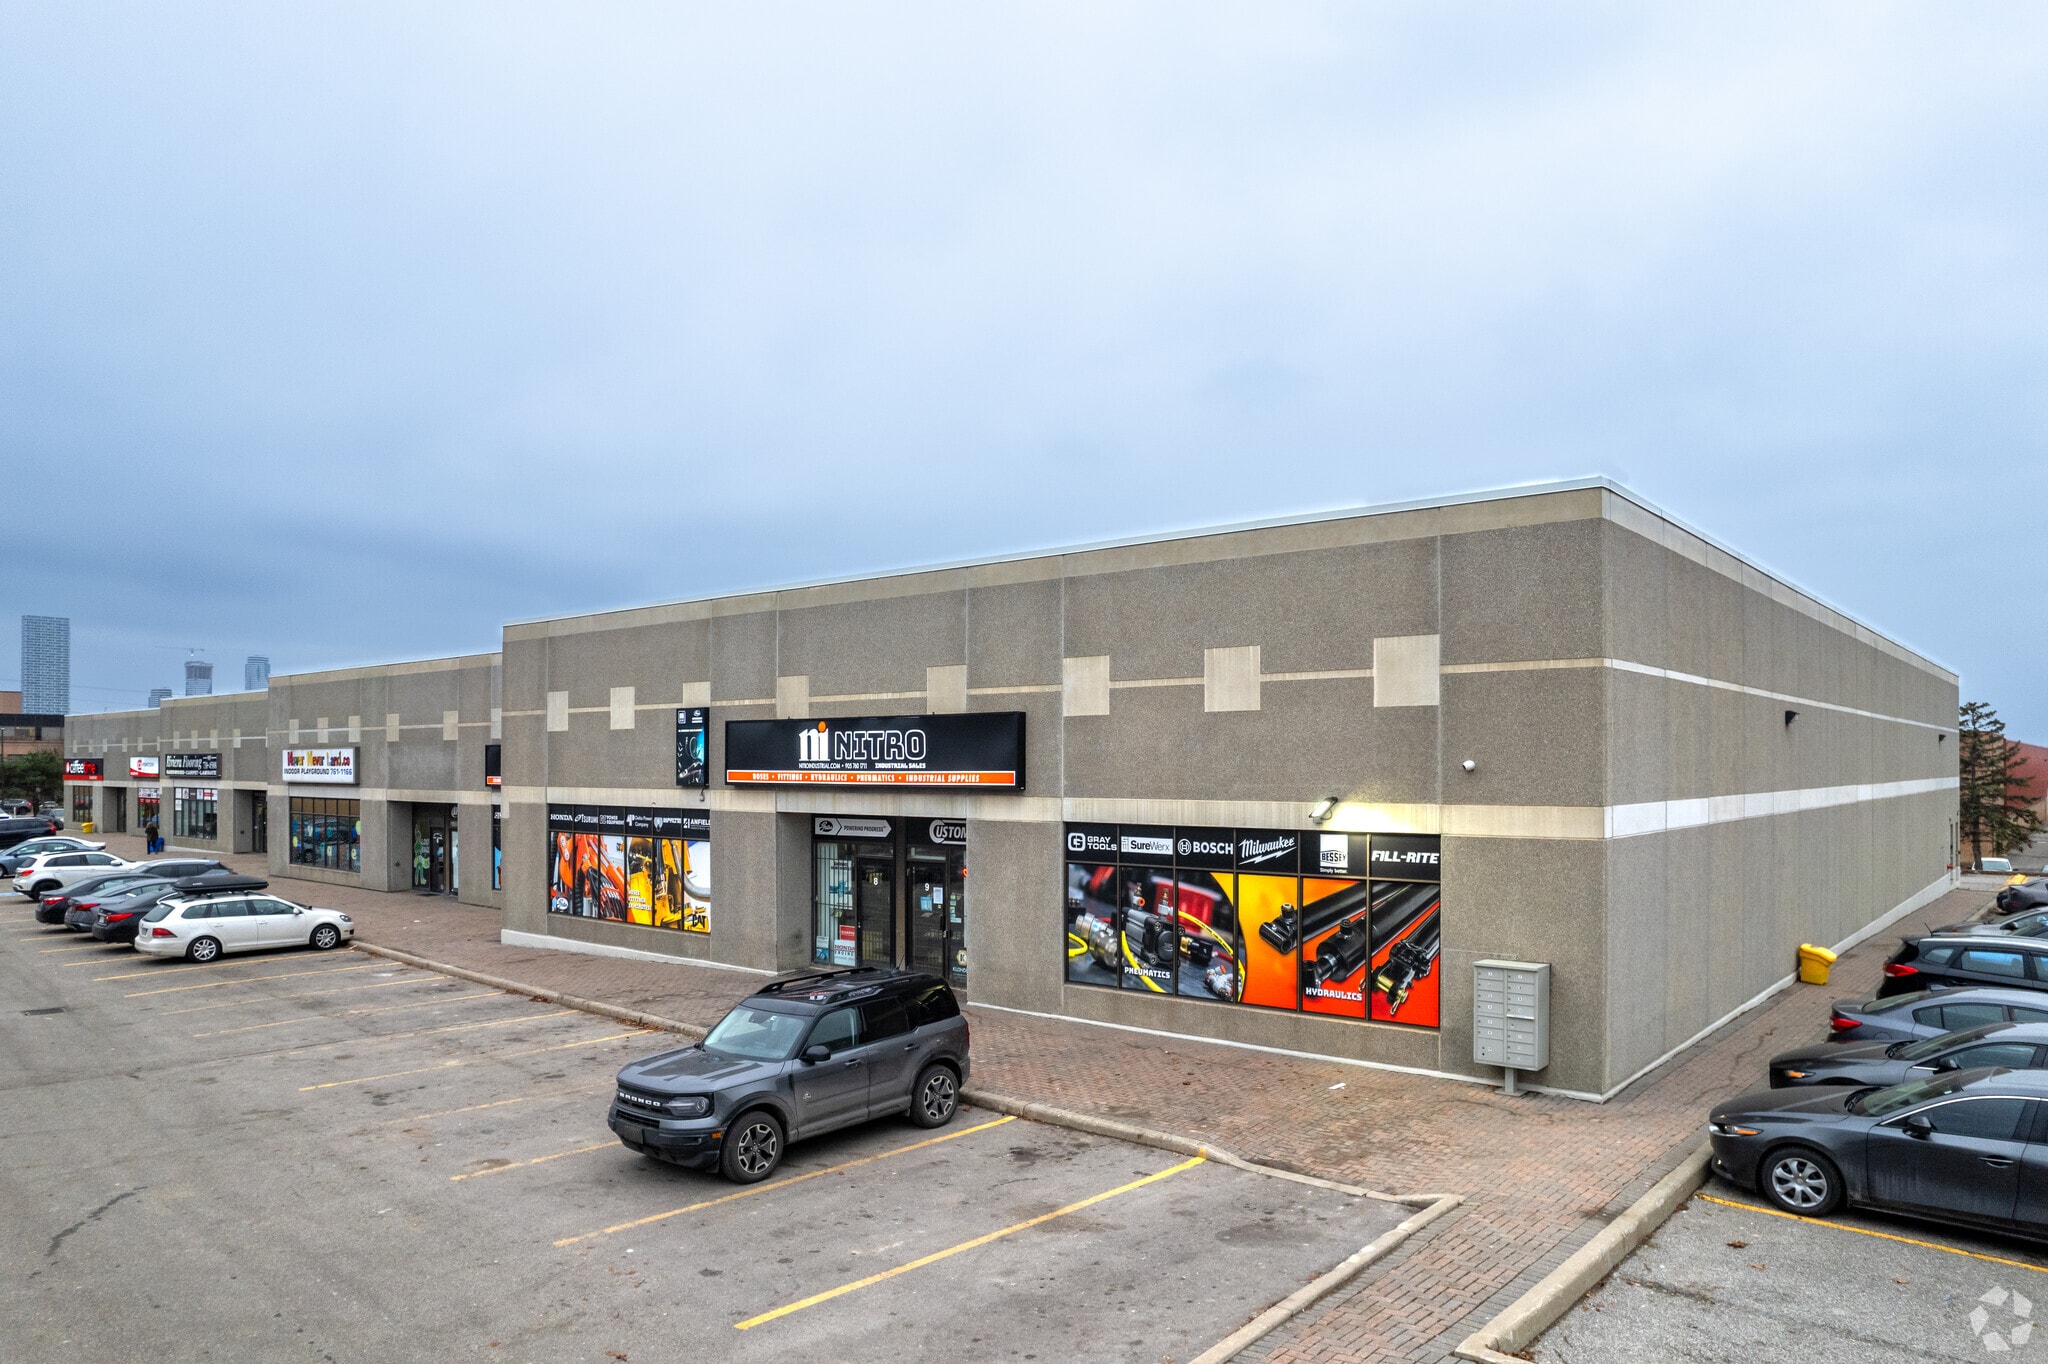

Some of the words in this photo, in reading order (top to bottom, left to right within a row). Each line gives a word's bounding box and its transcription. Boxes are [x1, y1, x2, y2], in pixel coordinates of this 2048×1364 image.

[834, 729, 927, 760] NITRO
[777, 773, 803, 781] FITTINGS
[810, 774, 848, 782] HYDRAULICS
[856, 774, 895, 782] PNEUMATICS
[905, 774, 945, 782] INDUSTRIAL
[947, 774, 980, 783] SUPPLIES
[550, 813, 574, 821] HONDA
[1086, 842, 1117, 850] TOOLS
[1087, 836, 1111, 844] GRAY
[1130, 840, 1170, 851] SureWerx
[1192, 841, 1234, 855] BOSCH
[1238, 836, 1295, 858] Milwaukee
[1321, 851, 1347, 862] BESSEY
[1371, 850, 1440, 864] FILL-RITE
[873, 877, 879, 886] 8
[924, 883, 930, 891] 9
[692, 913, 706, 929] CAT
[1124, 966, 1171, 979] PNEUMATICS
[1305, 987, 1363, 1002] HYDRAULICS
[619, 1091, 661, 1107] BRONCO
